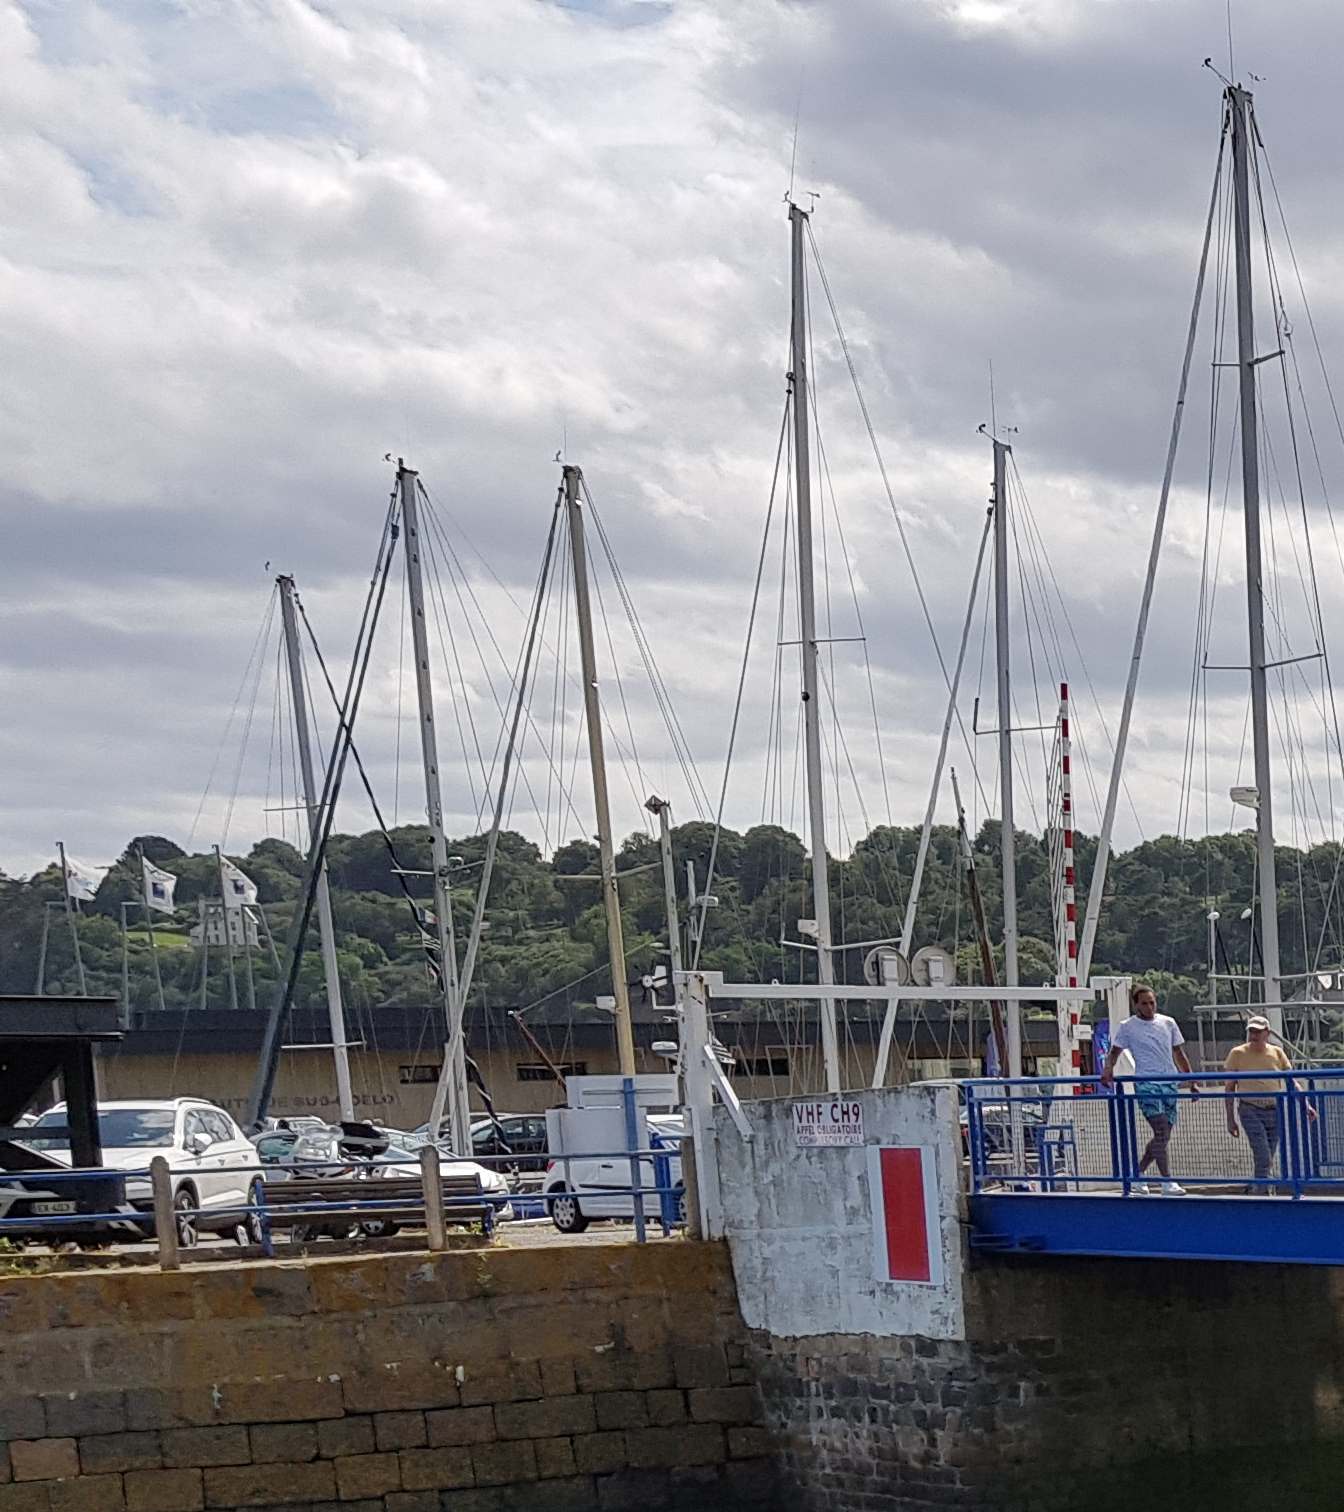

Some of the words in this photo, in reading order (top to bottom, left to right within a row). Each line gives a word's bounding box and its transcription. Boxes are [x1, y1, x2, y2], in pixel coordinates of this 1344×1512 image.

[795, 1104, 823, 1124] VHF
[830, 1103, 860, 1124] CH9
[796, 1125, 815, 1135] APPEL
